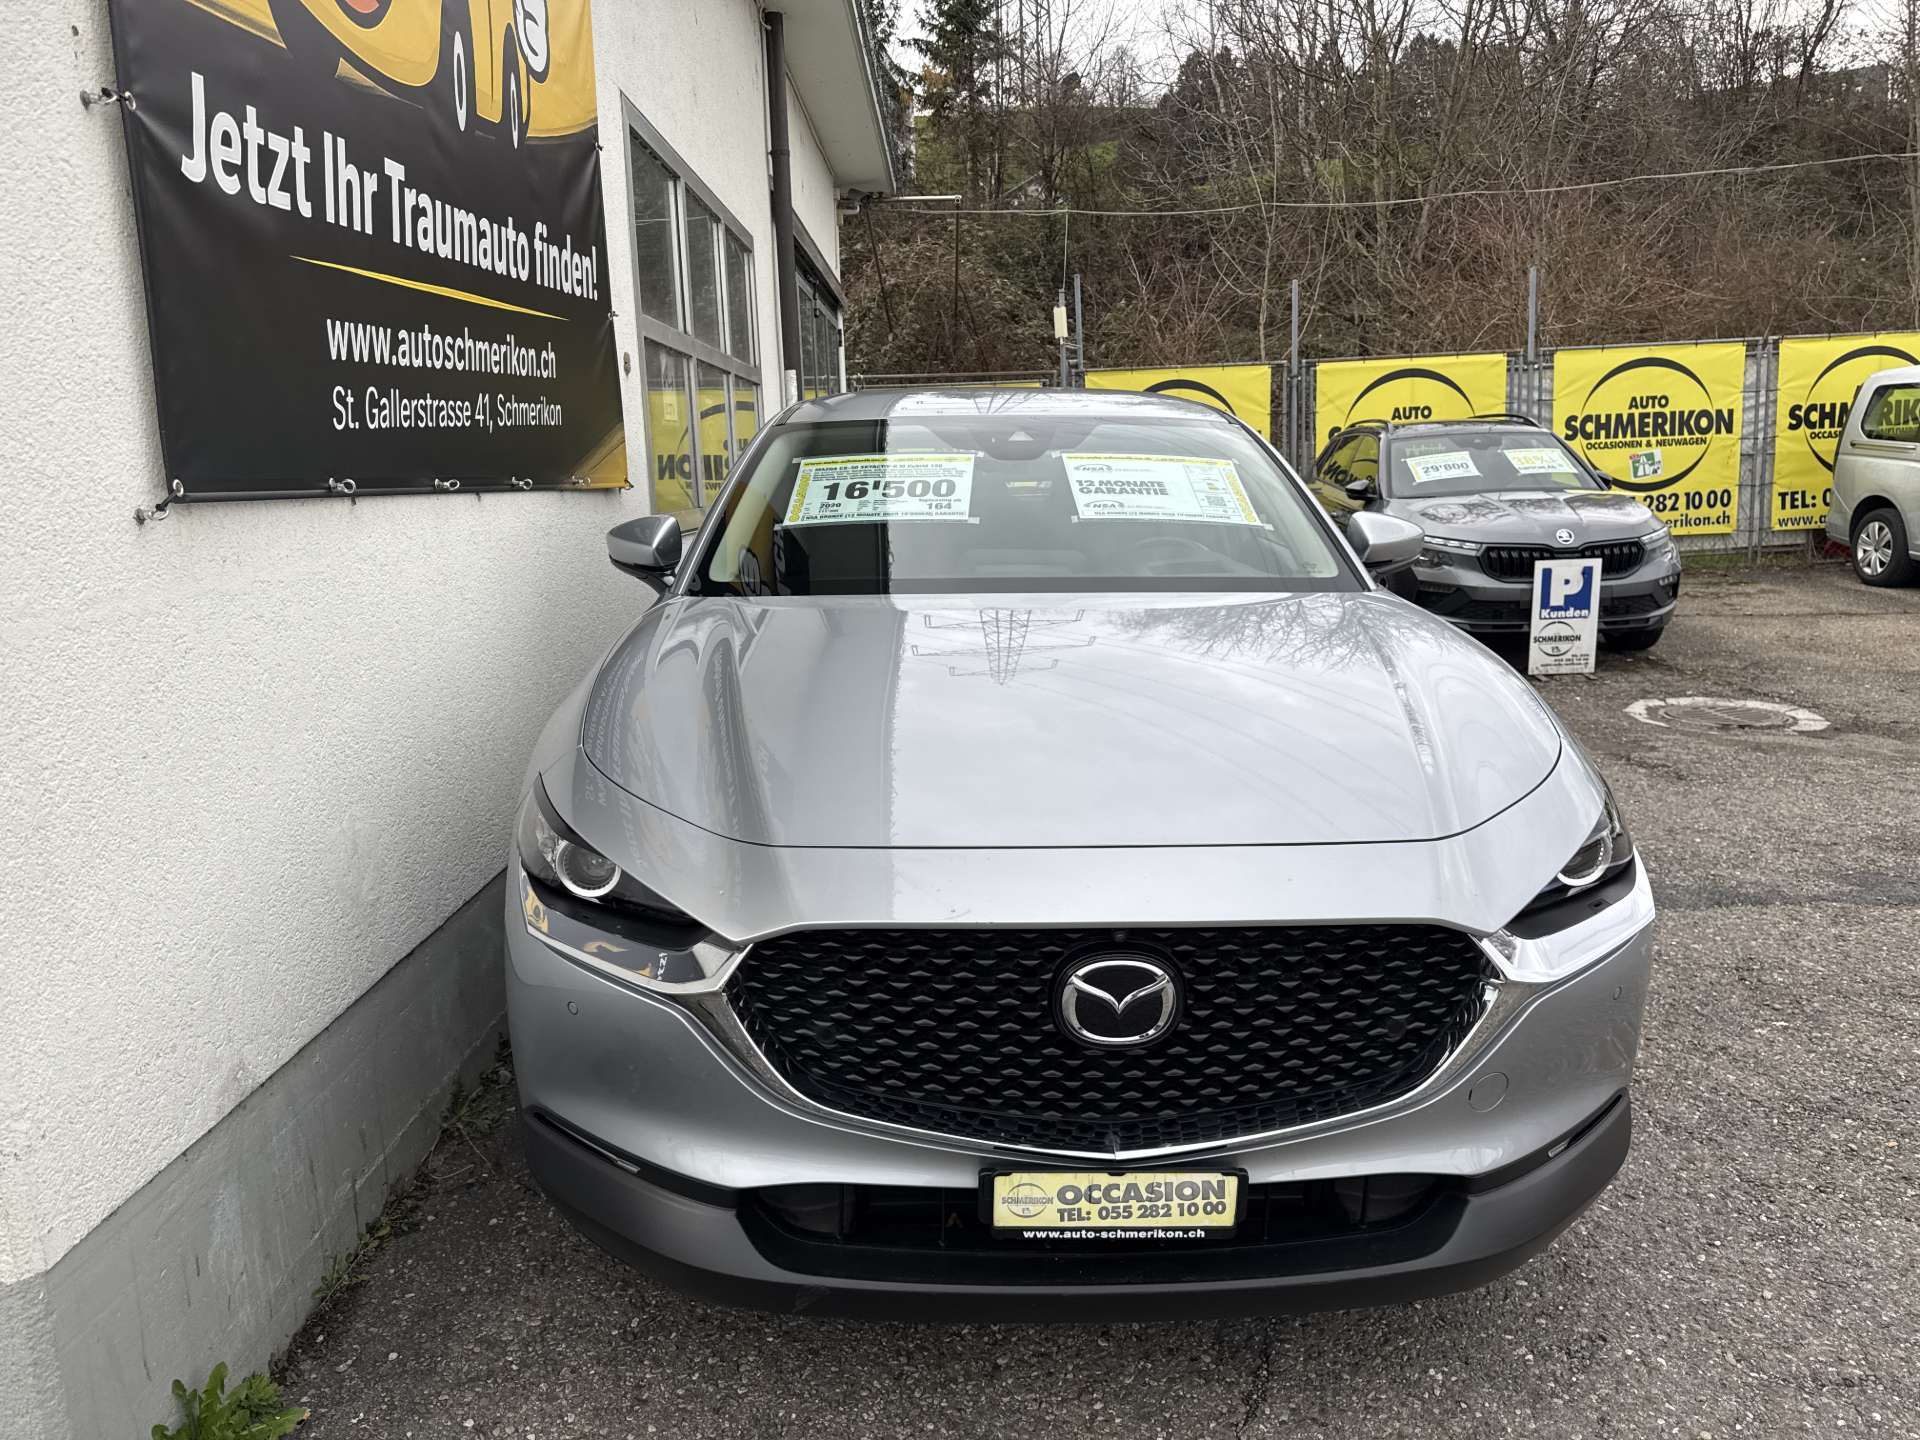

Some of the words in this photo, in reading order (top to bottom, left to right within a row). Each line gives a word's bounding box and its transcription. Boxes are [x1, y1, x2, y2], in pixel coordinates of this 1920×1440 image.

[180, 71, 313, 218] Jetzt
[323, 131, 378, 236] Ihr
[384, 157, 529, 281] Traumauto
[534, 220, 598, 301] finden!
[326, 318, 557, 380] www.autoschmerikon.ch
[332, 386, 359, 430] St.
[366, 388, 471, 429] Gallerstrasse
[475, 393, 492, 436] 41,
[497, 393, 562, 427] Schmerikon
[1391, 405, 1432, 420] AUTO
[1628, 395, 1669, 410] AUTO
[1564, 409, 1734, 442] SCHMERIKON
[1585, 438, 1643, 450] OCCASIONEN
[1645, 438, 1653, 448] &
[1655, 436, 1707, 448] NEUWAGEN
[823, 479, 957, 501] 16'500
[1076, 480, 1096, 488] 12
[1099, 480, 1165, 488] MONATE
[1079, 487, 1169, 496] GARANTIE
[1684, 491, 1703, 510] 10
[1707, 489, 1732, 508] 00
[1778, 491, 1817, 511] TEL:
[1541, 608, 1589, 619] Kunden
[1056, 1180, 1225, 1206] OCCASION
[1056, 1207, 1091, 1222] TEL:
[1097, 1204, 1132, 1220] 055
[1137, 1203, 1172, 1219] 282
[1177, 1202, 1199, 1216] 10
[1202, 1200, 1227, 1215] 00
[1023, 1228, 1205, 1239] www.auto-schmerikon.ch
